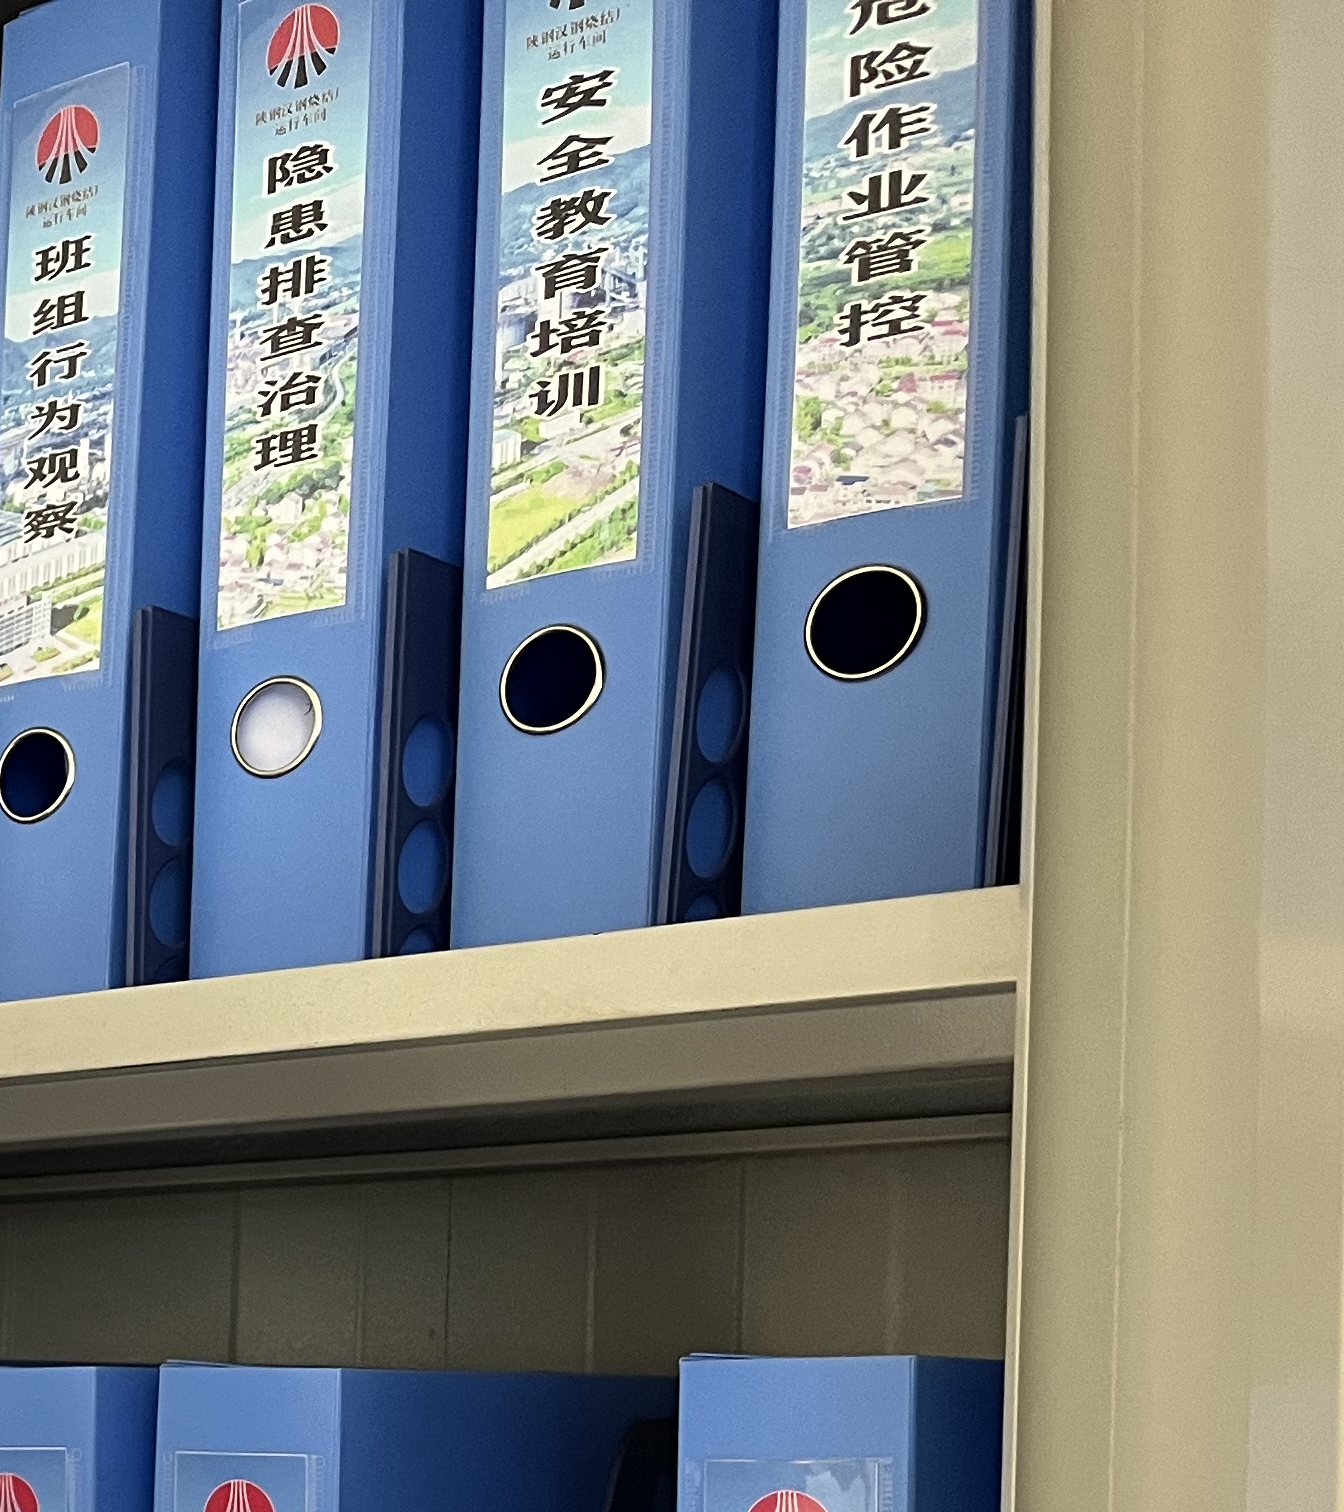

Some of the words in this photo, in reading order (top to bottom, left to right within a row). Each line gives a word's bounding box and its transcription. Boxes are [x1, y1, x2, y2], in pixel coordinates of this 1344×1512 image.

[253, 144, 334, 471] 隐患排查治理
[528, 70, 616, 417] 安全教育培训
[838, 0, 932, 348] 危险作业管控
[23, 235, 92, 543] 班组行为观察
